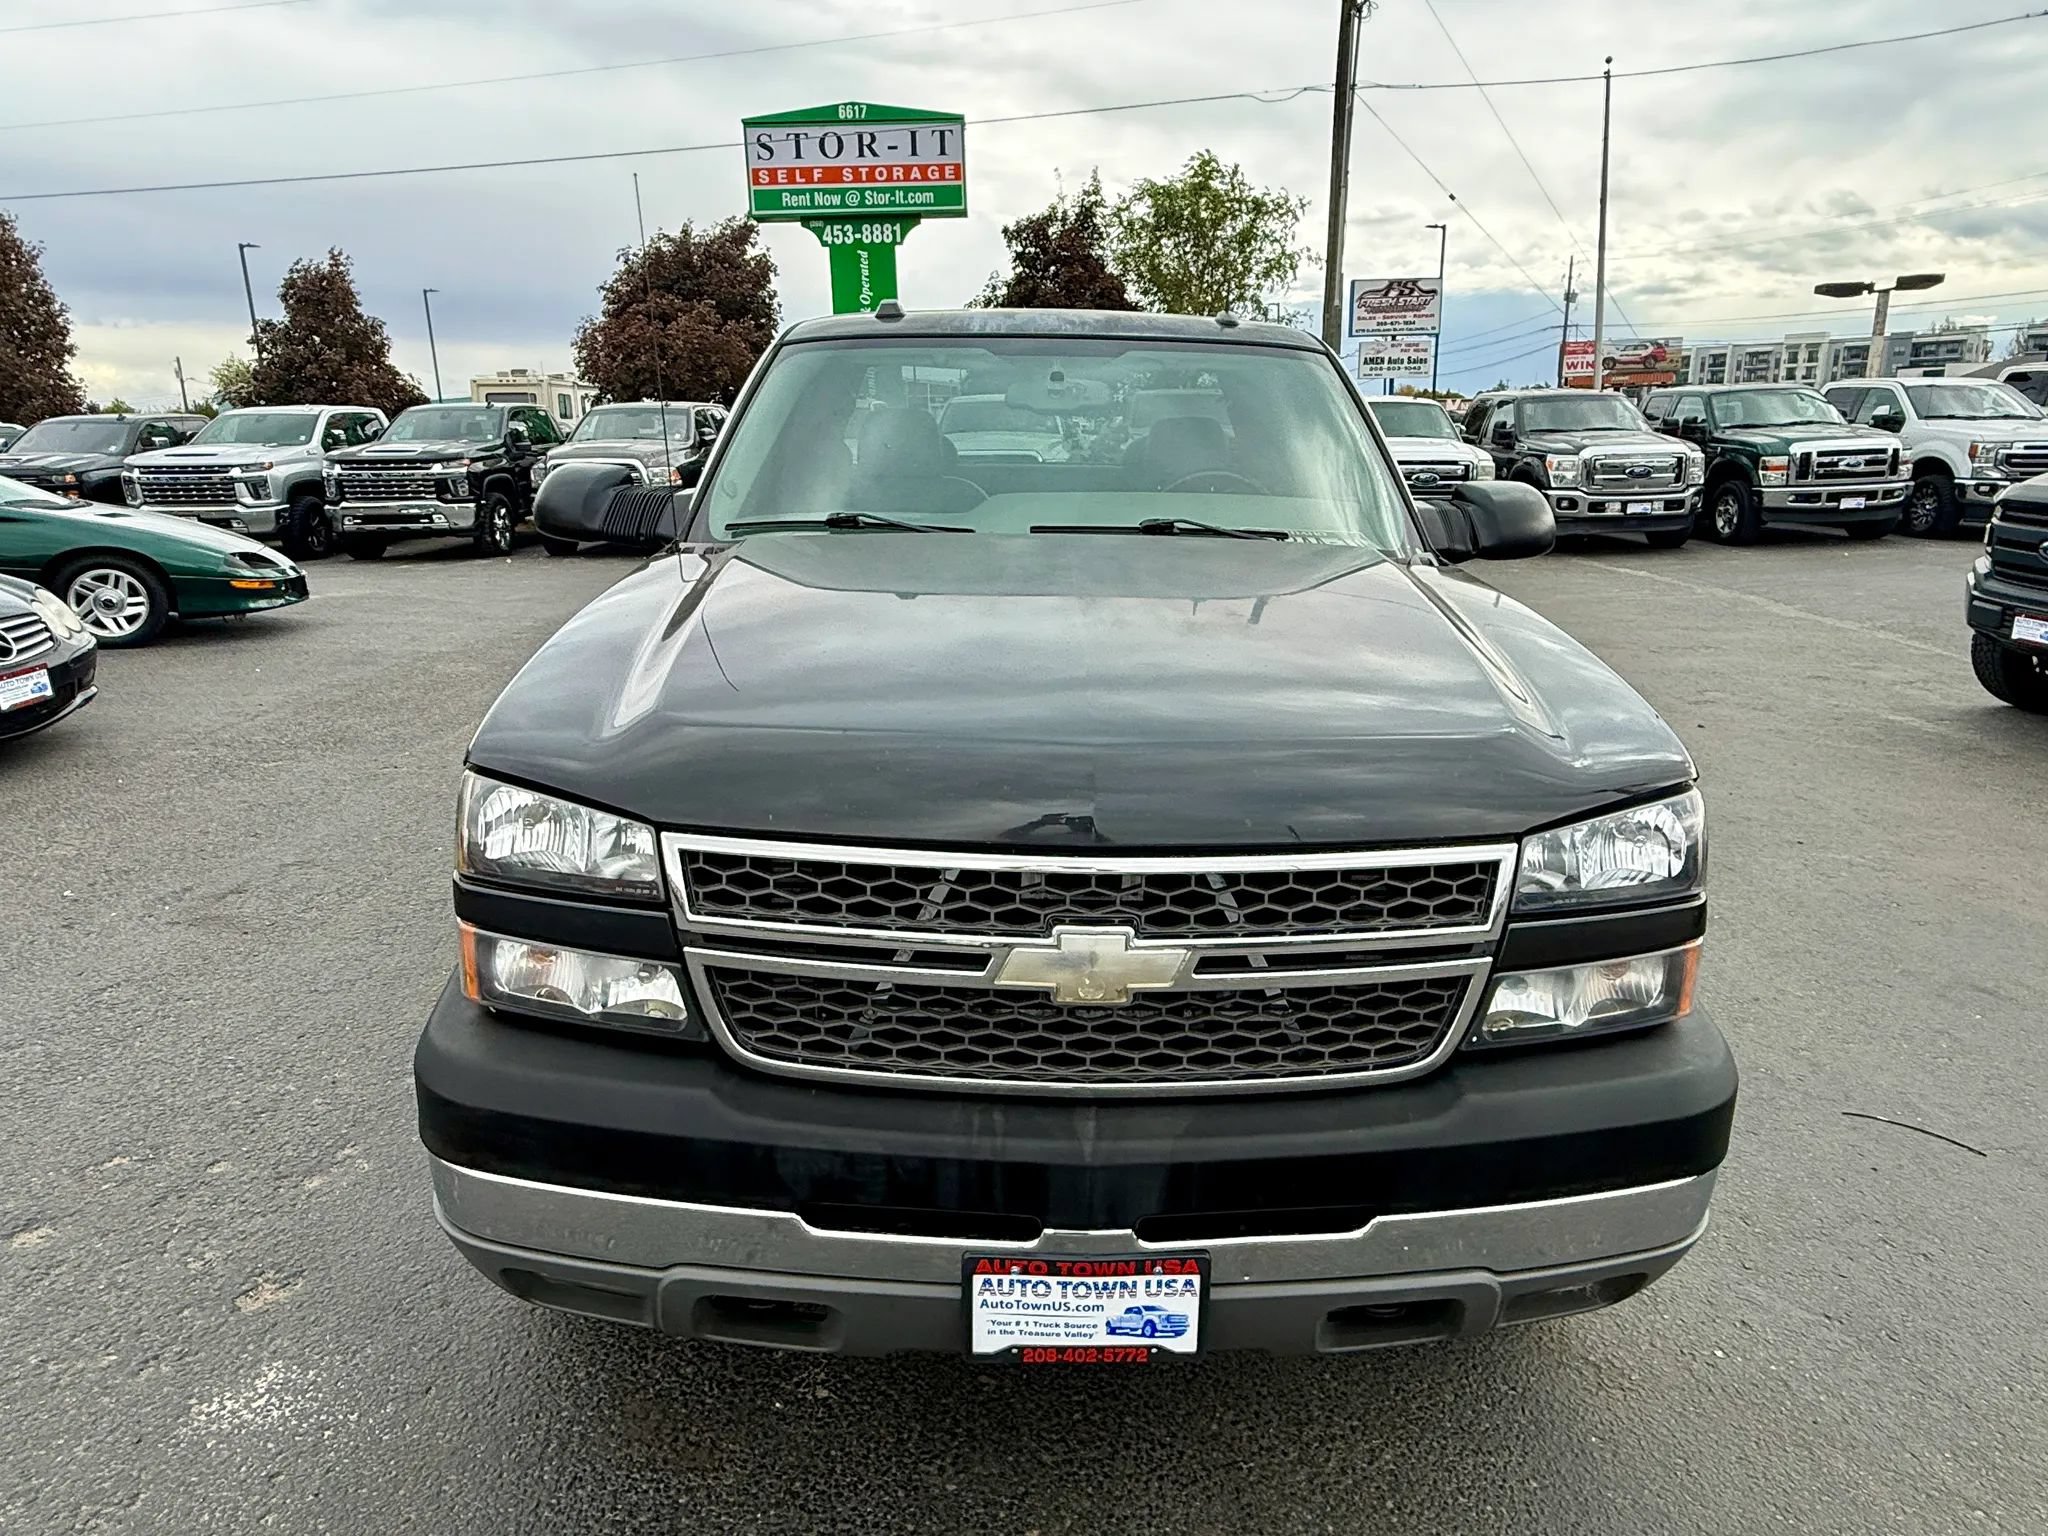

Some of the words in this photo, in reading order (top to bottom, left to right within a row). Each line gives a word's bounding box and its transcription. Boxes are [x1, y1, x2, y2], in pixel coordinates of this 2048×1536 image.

[838, 104, 867, 120] 6617
[756, 129, 954, 161] STOR-IT
[758, 168, 824, 184] SELF
[842, 165, 956, 182] STORAGE
[782, 192, 811, 207] Rent
[814, 191, 841, 206] Now
[845, 190, 861, 206] @
[865, 190, 935, 206] Stor-It.com
[822, 223, 902, 244] 453-8881
[857, 249, 874, 305] Operated
[1357, 297, 1396, 309] FRESH
[1397, 295, 1435, 306] START
[1363, 356, 1385, 366] AMEN
[1387, 356, 1405, 365] Auto
[1407, 356, 1428, 365] Sales
[975, 1259, 1048, 1274] AUTO
[1056, 1261, 1137, 1275] TOWN
[1144, 1259, 1199, 1274] USA
[978, 1278, 1052, 1298] AUTO
[1056, 1280, 1138, 1300] TOWN
[1145, 1279, 1198, 1298] USA
[980, 1299, 1104, 1313] AutoTownUS.com
[1033, 1321, 1061, 1329] Truck
